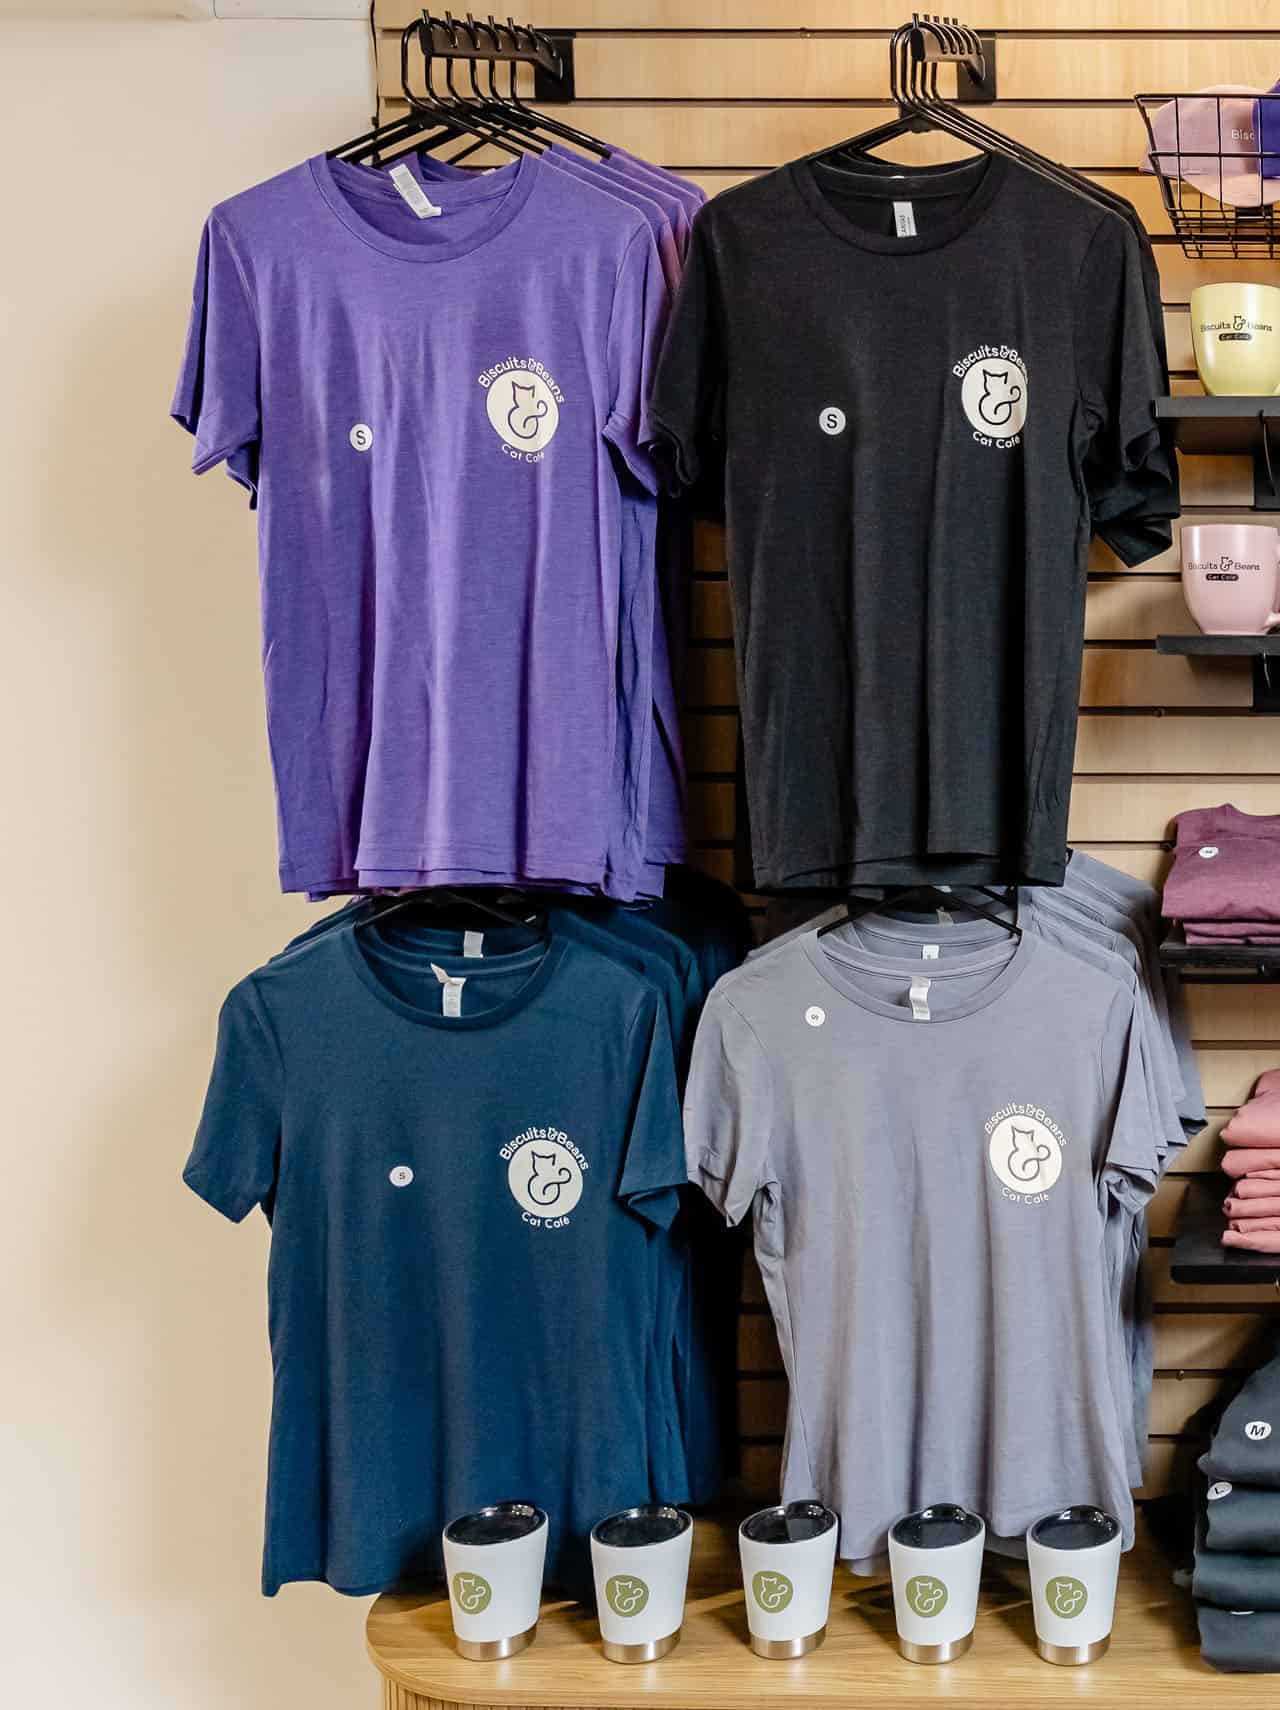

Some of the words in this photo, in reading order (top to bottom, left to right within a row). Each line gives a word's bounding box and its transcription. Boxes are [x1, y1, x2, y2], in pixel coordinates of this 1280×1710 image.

[952, 344, 999, 378] Biscuits
[478, 356, 527, 388] Biscuits
[535, 362, 565, 403] Beans
[827, 414, 837, 429] S
[356, 430, 366, 446] S
[972, 430, 993, 447] Cat
[1188, 562, 1218, 570] Biscuits
[1234, 562, 1261, 571] Beans
[984, 1103, 1025, 1135] Biscuits
[1035, 1108, 1067, 1146] Beans
[499, 1127, 547, 1161] Biscuits
[557, 1131, 589, 1171] Beans
[1002, 1186, 1020, 1203] Cat
[521, 1211, 541, 1227] Cat
[1250, 1424, 1265, 1436] M
